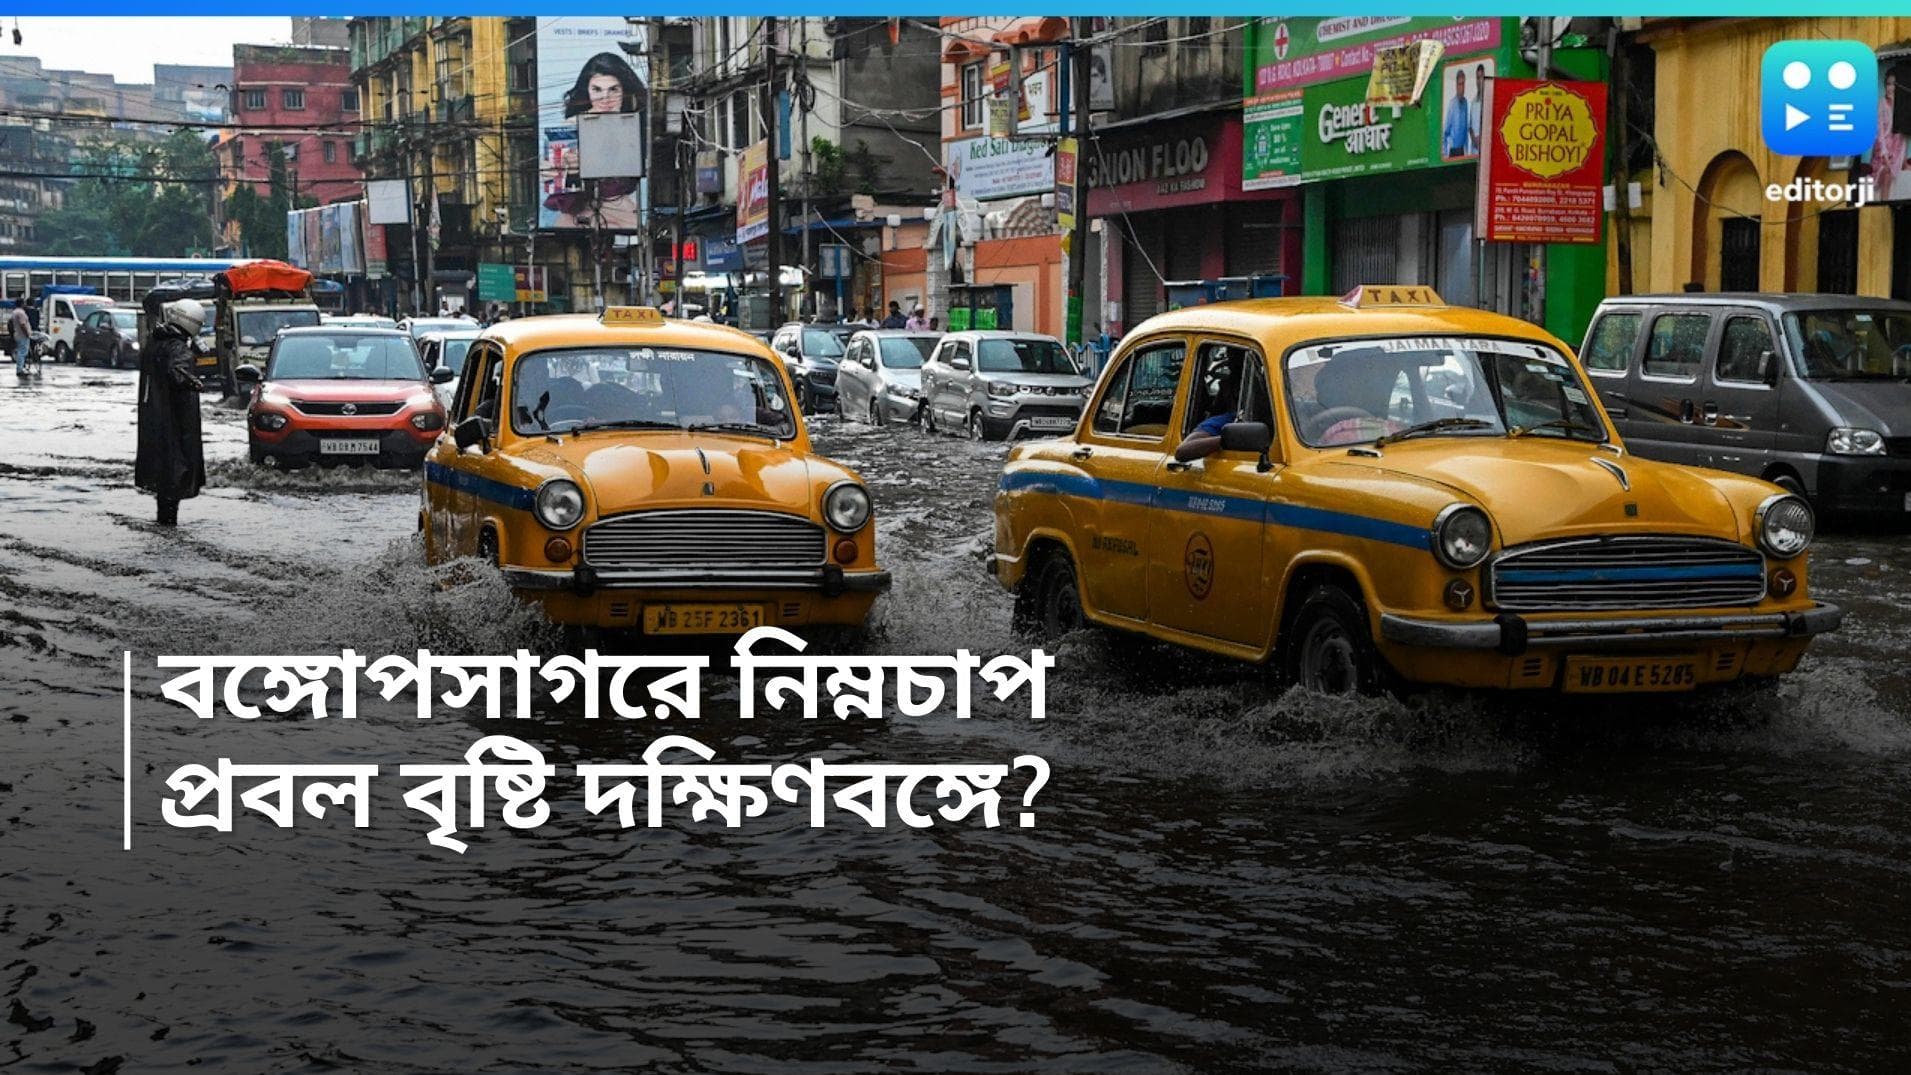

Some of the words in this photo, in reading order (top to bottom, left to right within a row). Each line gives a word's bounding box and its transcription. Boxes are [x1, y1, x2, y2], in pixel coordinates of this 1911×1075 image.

[1519, 123, 1578, 143] GOPAL
[1515, 144, 1581, 163] BISHOYI
[1368, 289, 1432, 304] TAXI
[613, 310, 654, 319] TAXI
[719, 610, 759, 628] 2361
[1649, 663, 1695, 686] 5285
